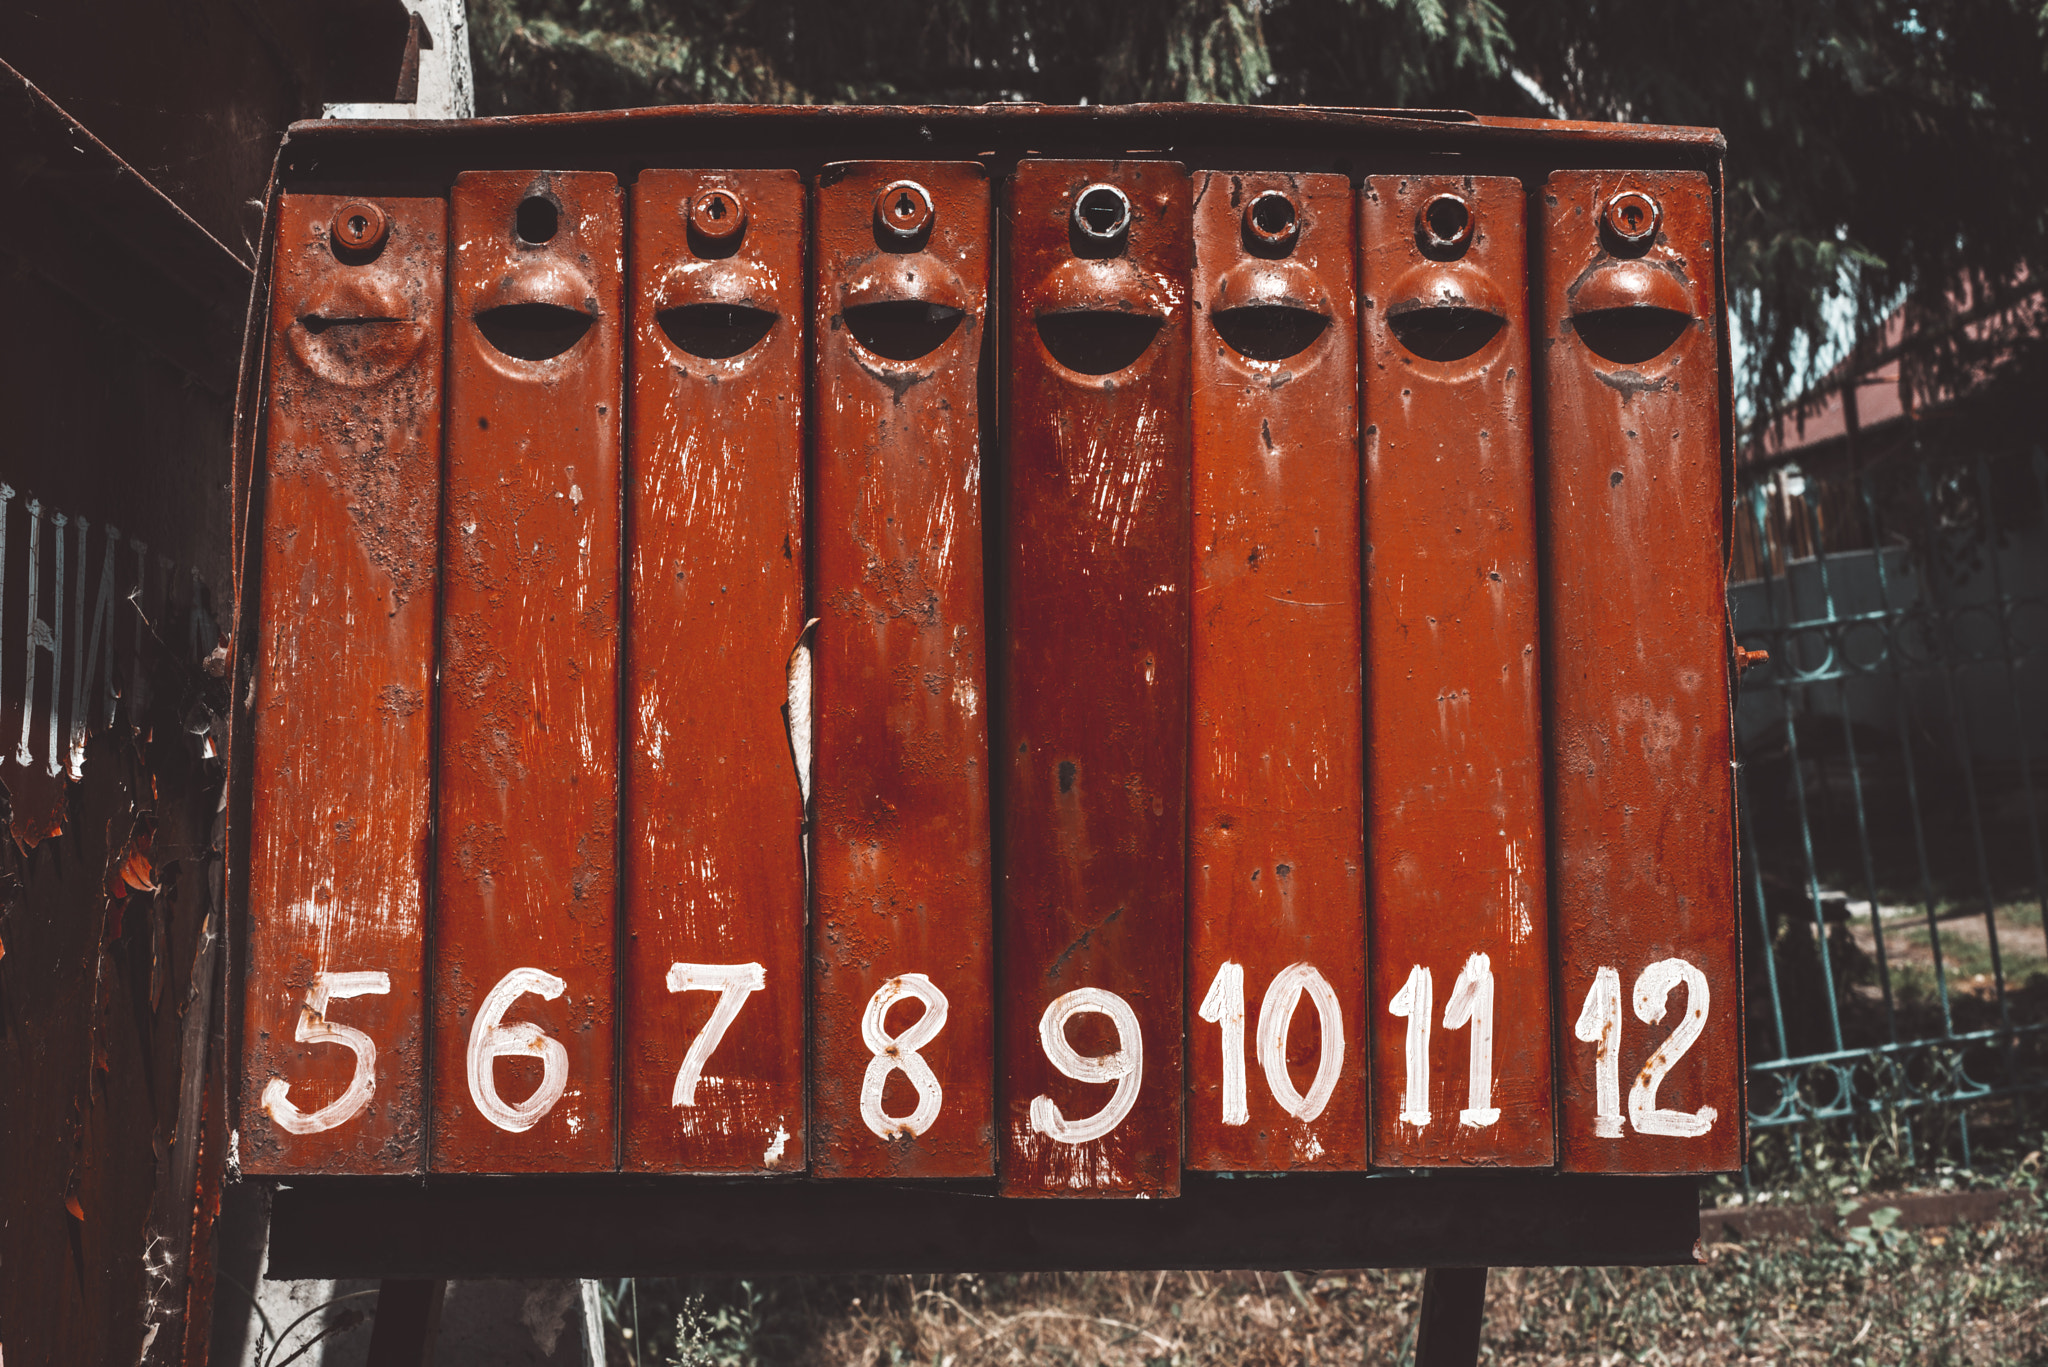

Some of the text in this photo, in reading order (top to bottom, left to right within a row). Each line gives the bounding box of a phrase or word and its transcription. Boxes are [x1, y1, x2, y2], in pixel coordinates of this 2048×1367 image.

[261, 970, 390, 1134] 5
[467, 967, 568, 1133] 6
[666, 962, 766, 1107] 7
[860, 973, 949, 1141] 8
[1029, 987, 1143, 1146] 9
[1198, 962, 1345, 1124] 10
[1388, 952, 1498, 1129] 11
[1575, 957, 1718, 1138] 12
